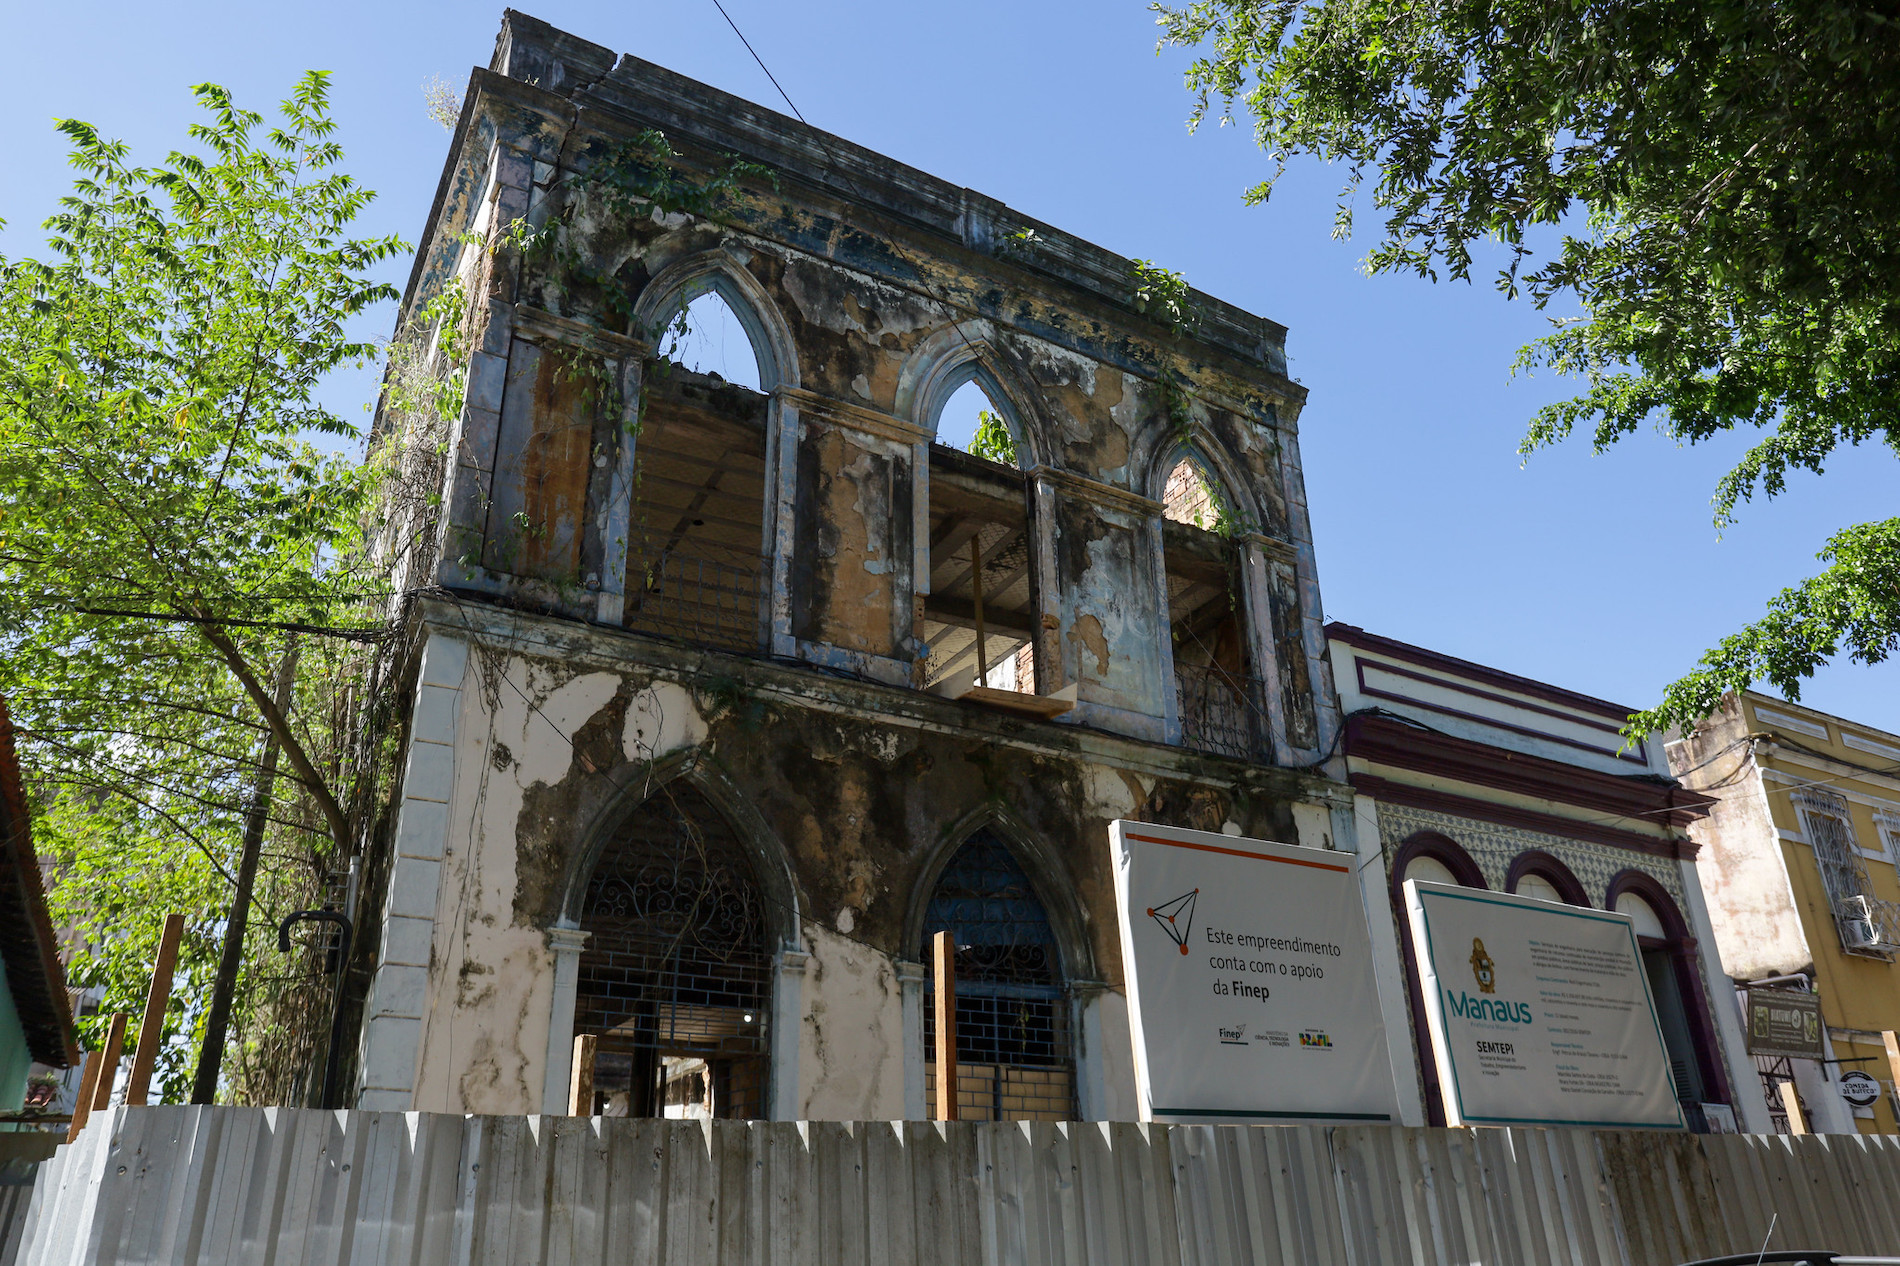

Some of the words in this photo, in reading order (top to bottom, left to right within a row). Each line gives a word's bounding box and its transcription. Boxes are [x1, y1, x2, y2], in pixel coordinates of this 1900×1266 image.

[1206, 927, 1234, 945] Este
[1237, 934, 1341, 957] empreendimento
[1209, 956, 1246, 972] conta
[1249, 960, 1276, 974] com
[1279, 963, 1287, 975] o
[1290, 963, 1324, 981] apoio
[1213, 978, 1229, 995] da
[1232, 981, 1270, 1003] Finep
[1447, 989, 1532, 1024] Manaus
[1219, 1028, 1241, 1040] Finep
[1298, 1032, 1333, 1047] BRASIL
[1476, 1041, 1514, 1055] SEMTEPI
